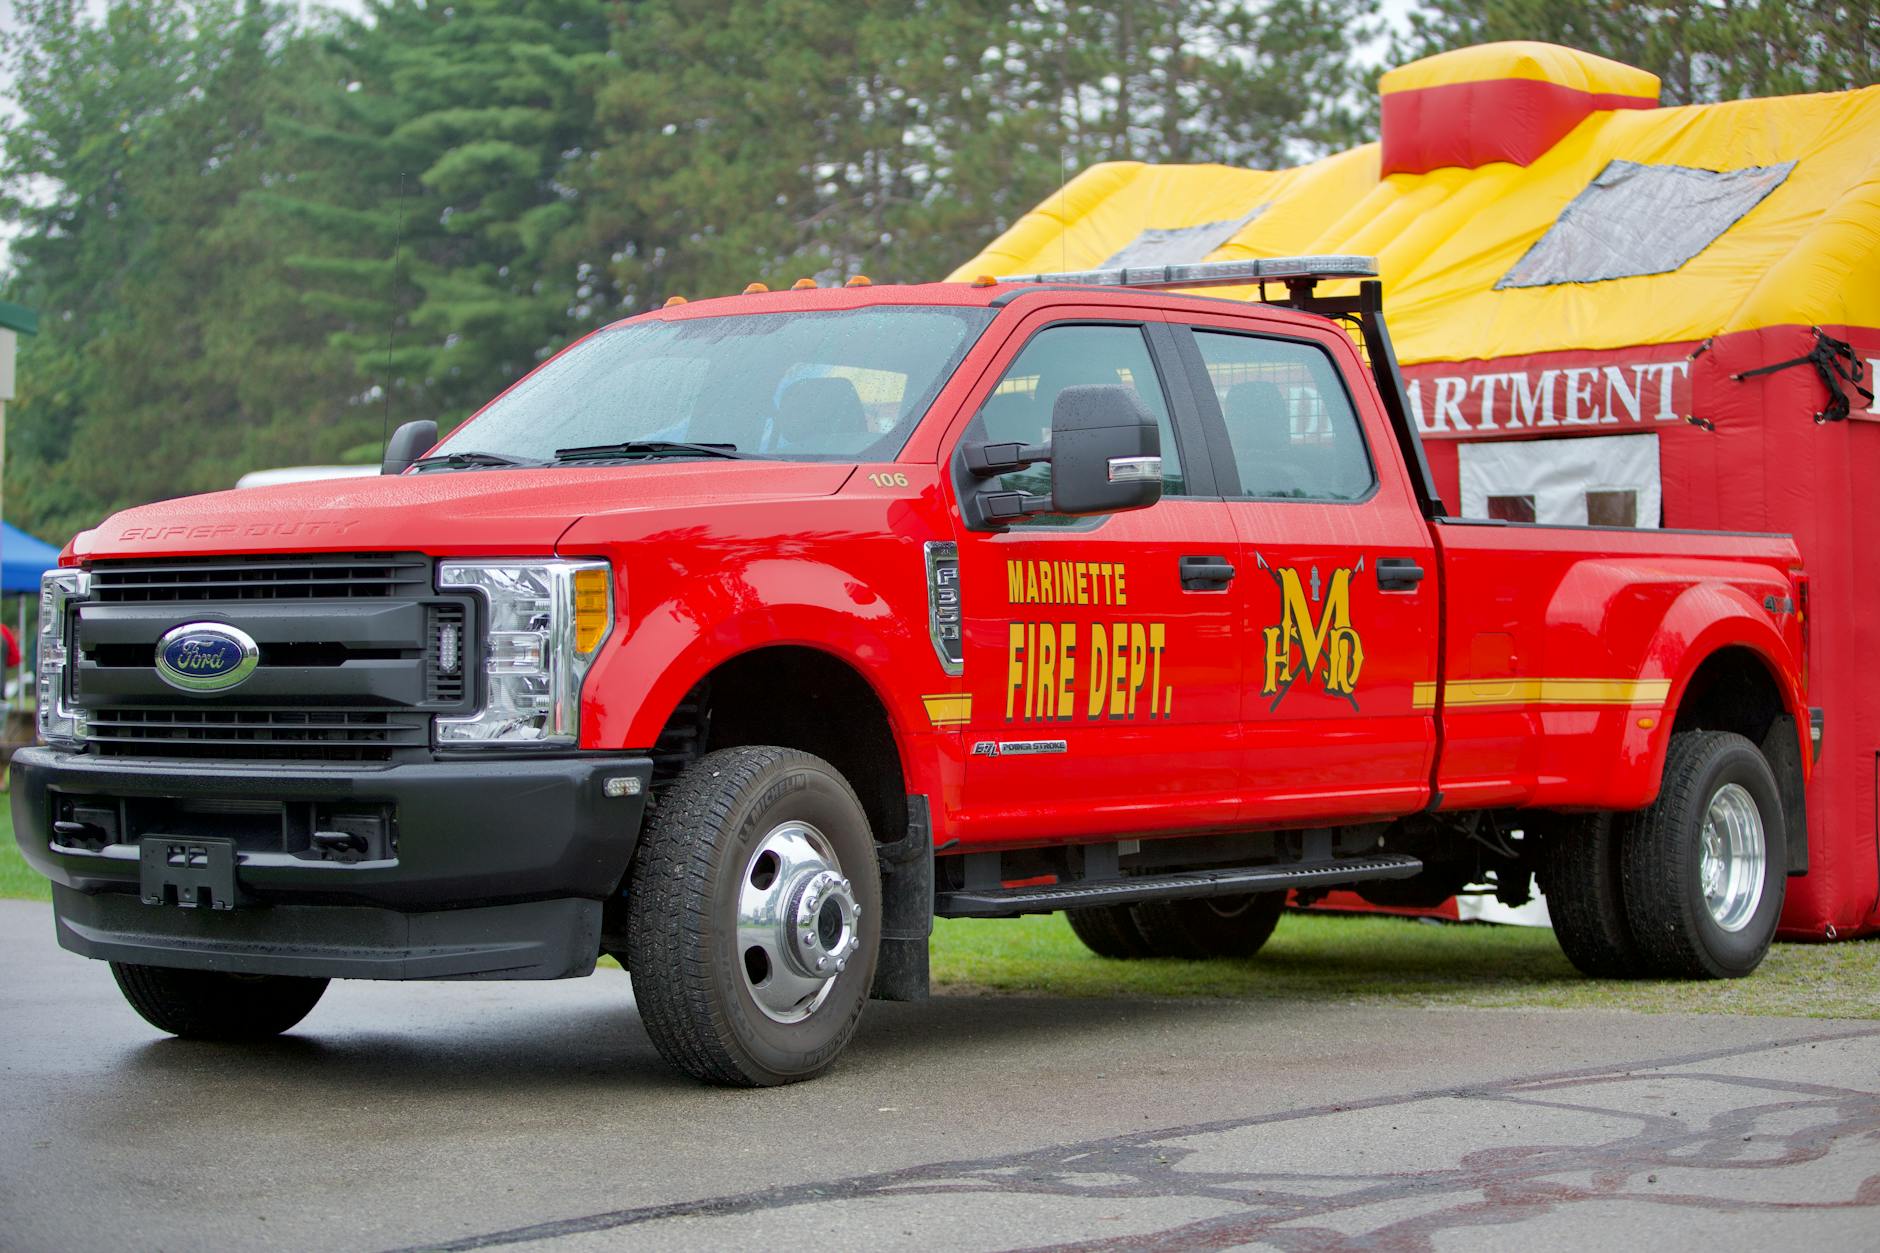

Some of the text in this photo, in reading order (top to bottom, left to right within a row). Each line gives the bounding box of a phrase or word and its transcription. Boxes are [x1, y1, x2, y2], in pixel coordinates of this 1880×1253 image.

[868, 472, 909, 487] 106
[119, 520, 360, 541] SUPER DUTY
[1007, 560, 1127, 606] MARINETTE
[177, 640, 226, 669] Ford
[1005, 622, 1173, 723] FIRE DEPT.
[1033, 741, 1065, 750] STROKE
